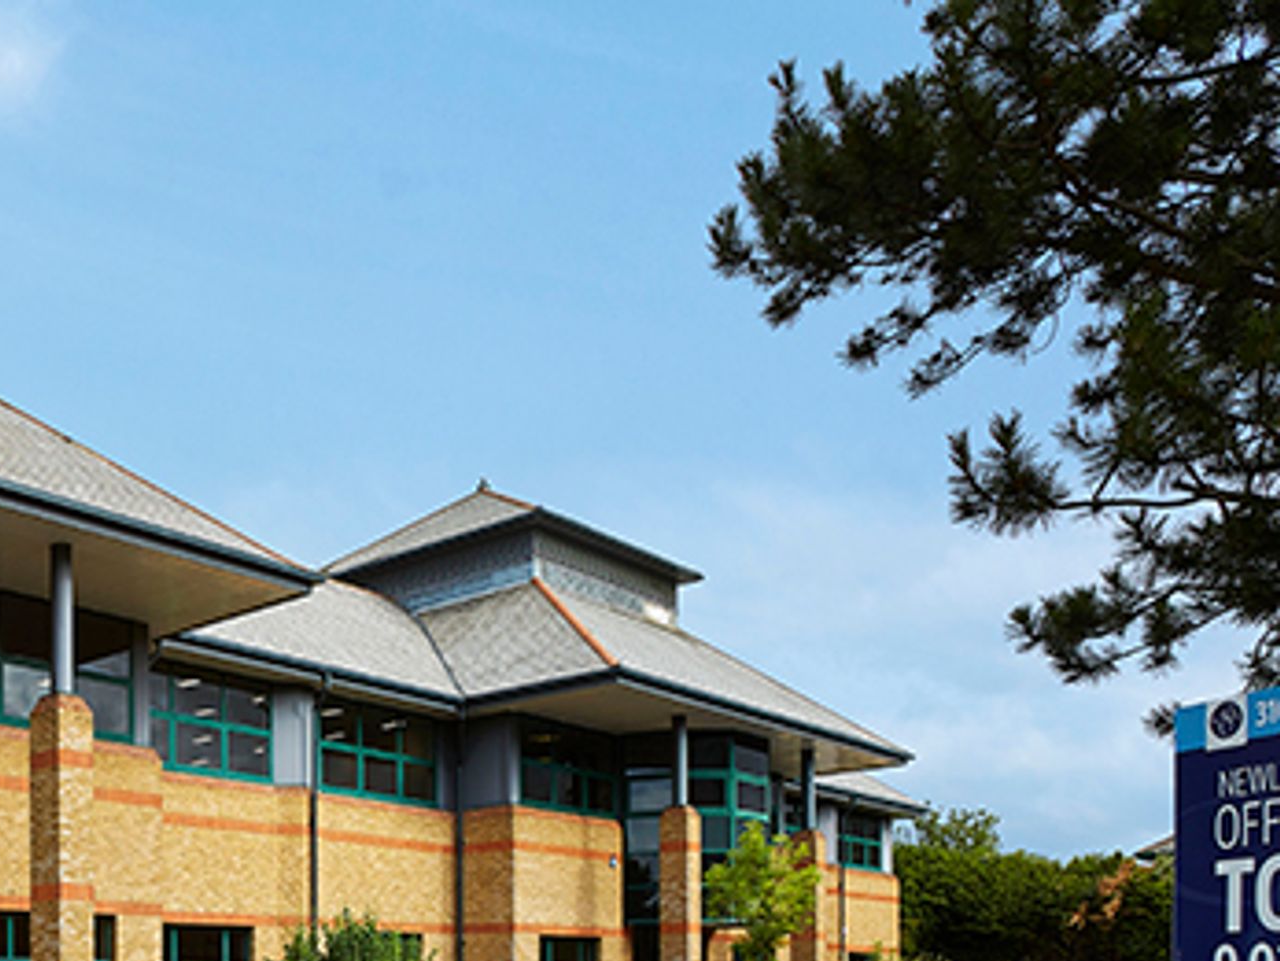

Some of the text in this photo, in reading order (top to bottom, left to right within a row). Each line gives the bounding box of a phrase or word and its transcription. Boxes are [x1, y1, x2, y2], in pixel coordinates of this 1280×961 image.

[1218, 763, 1280, 798] NEWL
[1214, 798, 1280, 849] OFF
[1214, 853, 1280, 932] TO
